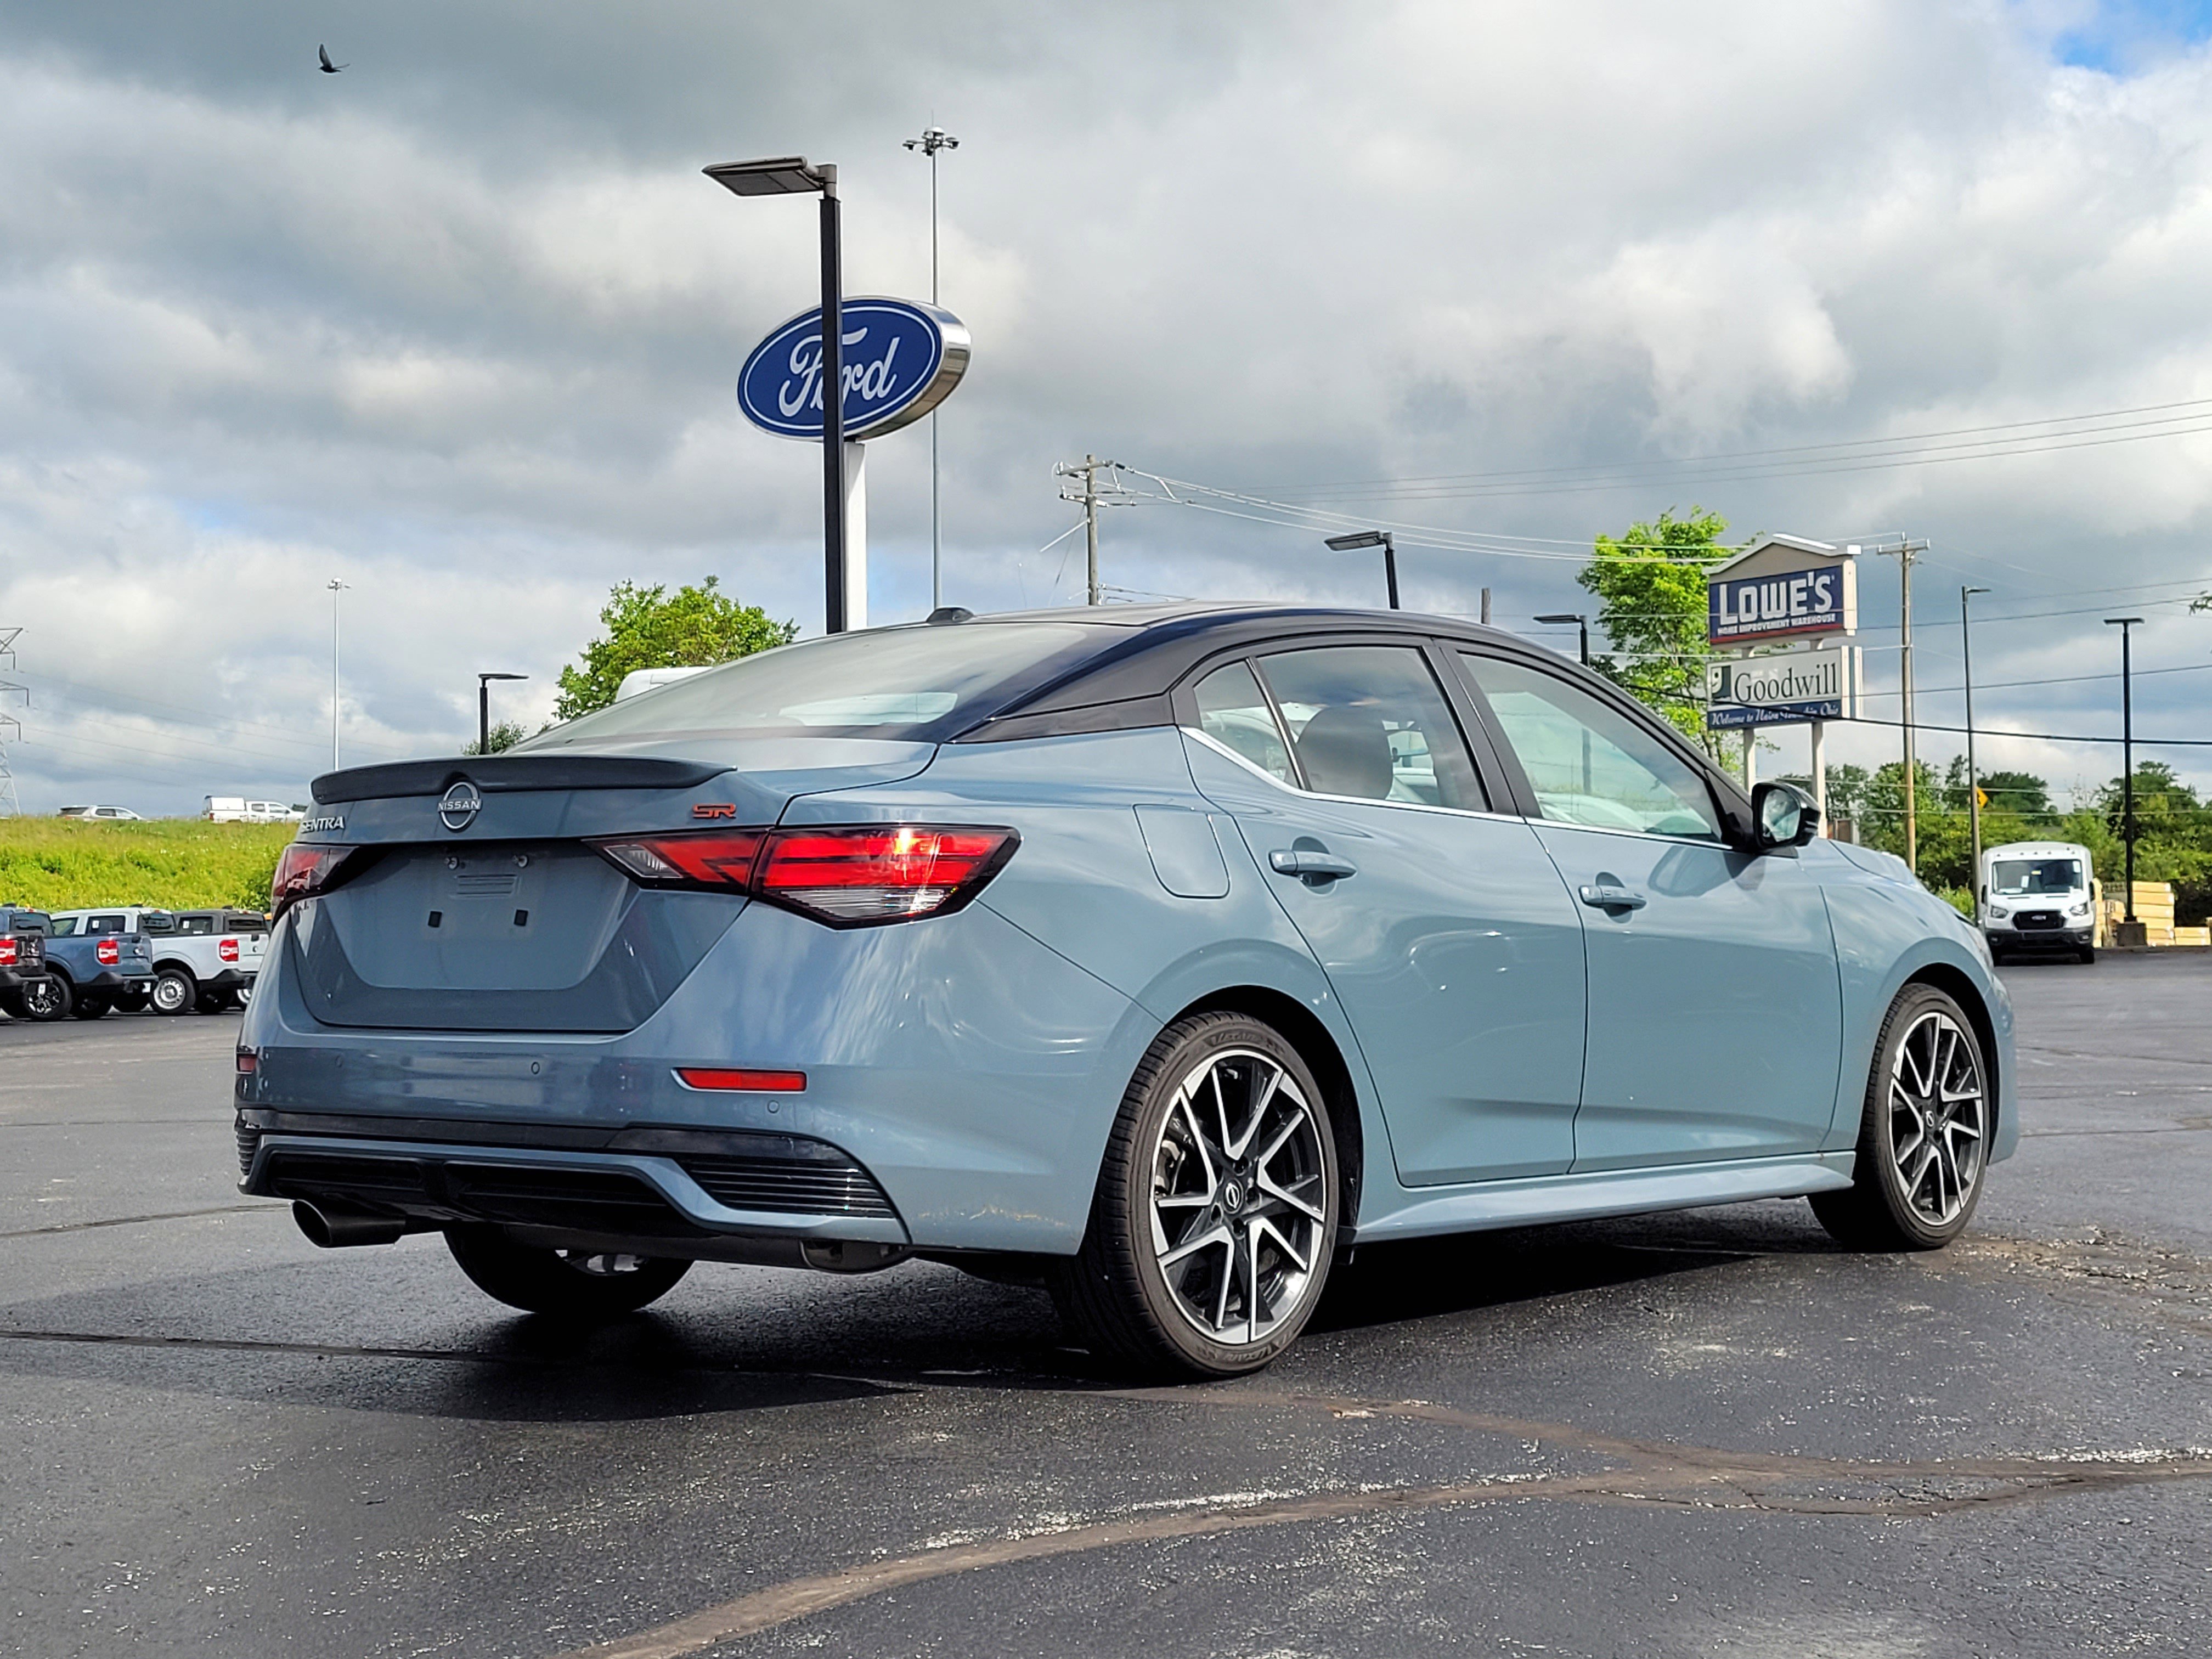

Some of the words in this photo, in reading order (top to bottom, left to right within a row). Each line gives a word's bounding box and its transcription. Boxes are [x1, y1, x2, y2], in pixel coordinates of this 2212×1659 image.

[1719, 572, 1832, 625] LOWE'S
[1718, 625, 1738, 636] HOME
[1739, 619, 1790, 633] IMPROVEMENT
[1791, 613, 1836, 627] WAREHOUSE
[1735, 663, 1837, 703] Goodwill
[438, 799, 481, 811] NISSAN
[692, 803, 736, 818] SR
[301, 816, 345, 833] SENTRA
